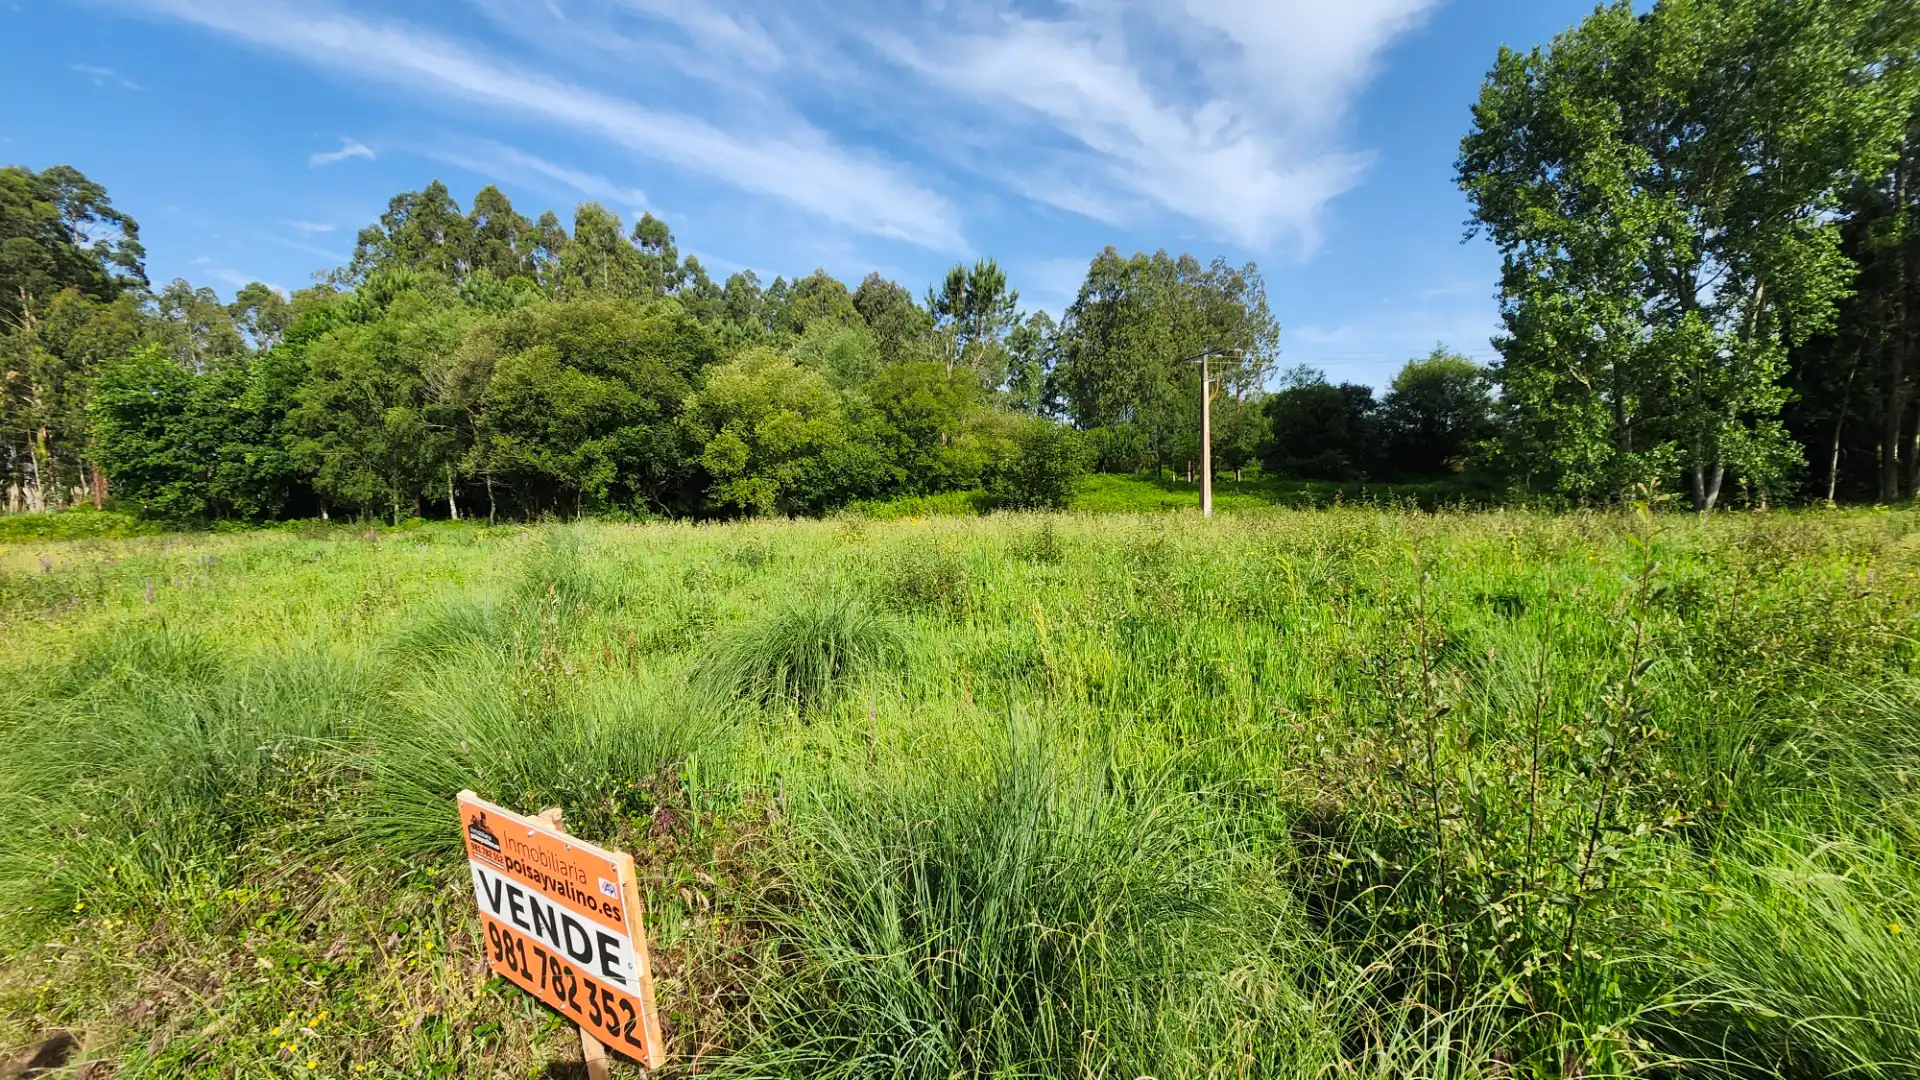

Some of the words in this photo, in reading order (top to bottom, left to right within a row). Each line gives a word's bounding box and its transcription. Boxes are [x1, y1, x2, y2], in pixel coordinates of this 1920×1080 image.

[504, 831, 587, 885] Inmobiliaria
[504, 855, 621, 921] poisayvalino.es
[477, 869, 627, 985] VENDE
[488, 921, 533, 982] 981
[533, 949, 582, 1014] 782
[584, 981, 642, 1049] 352
